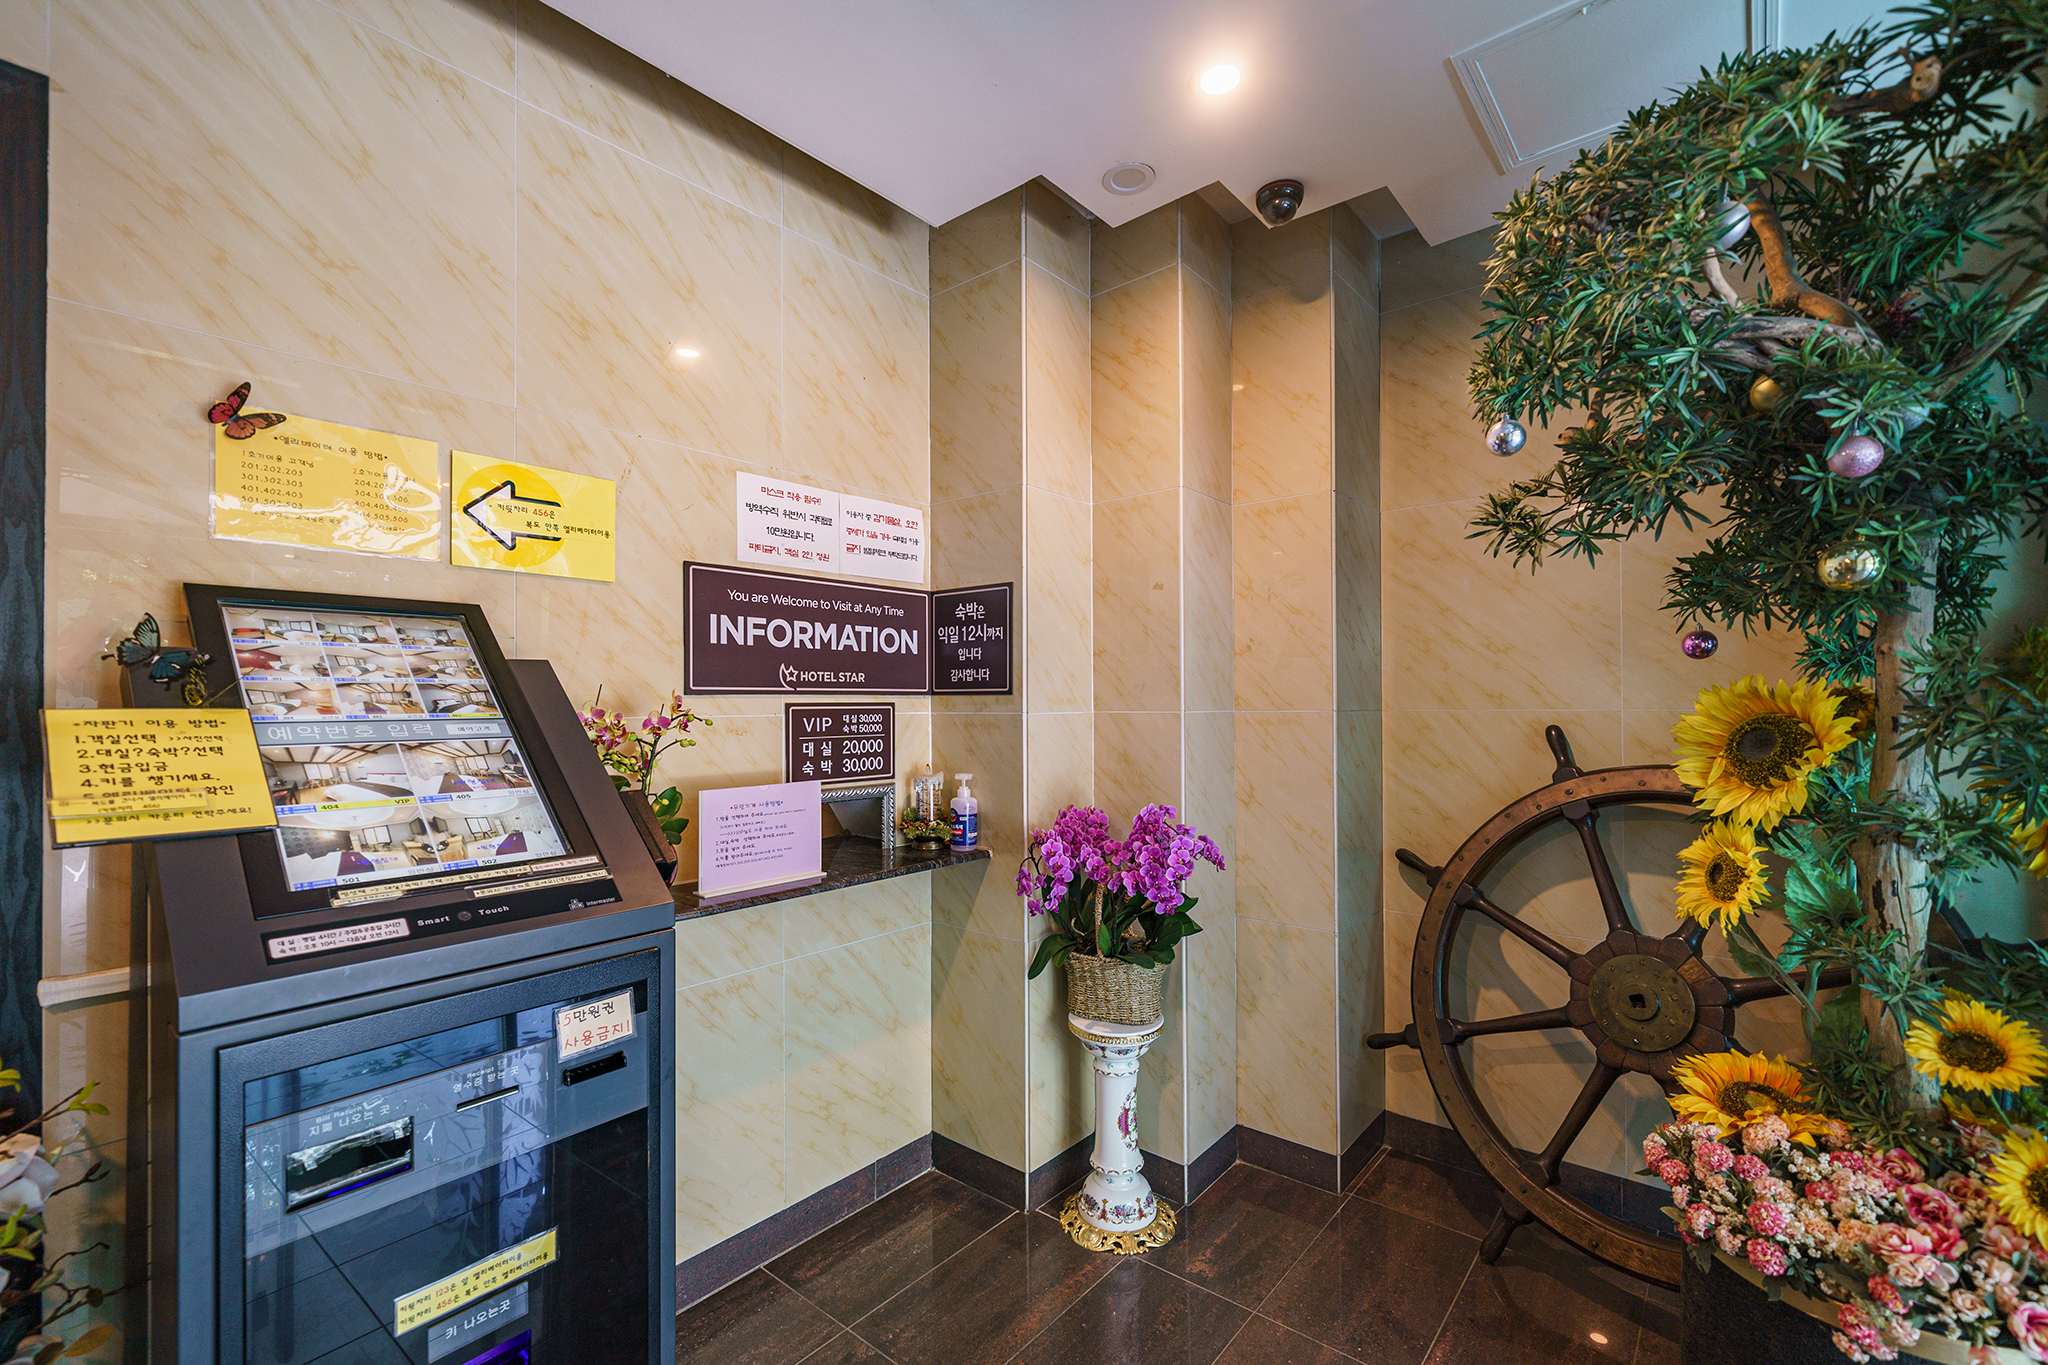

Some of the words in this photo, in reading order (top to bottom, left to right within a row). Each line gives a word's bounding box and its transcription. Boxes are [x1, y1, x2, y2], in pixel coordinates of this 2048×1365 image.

[338, 446, 358, 457] 이용
[364, 450, 383, 461] 방법
[241, 461, 303, 477] 201.202.203
[241, 472, 303, 488] 301.302.303
[241, 484, 303, 499] 401.402.403
[760, 486, 784, 499] 마스크
[532, 508, 556, 519] 456은
[782, 509, 807, 522] 위반시
[526, 520, 540, 530] 복도
[846, 543, 861, 554] 금지
[727, 588, 749, 603] You
[751, 593, 769, 604] are
[771, 593, 819, 609] Welcome
[820, 598, 831, 610] to
[832, 600, 853, 613] Visit
[853, 602, 864, 613] at
[864, 602, 882, 617] Any
[884, 605, 904, 617] Time
[955, 602, 986, 620] 숙박은
[710, 613, 918, 655] INFORMATION
[937, 624, 959, 644] 익일
[961, 623, 1004, 642] 12시까지
[957, 647, 982, 661] 입니다
[800, 670, 837, 683] HOTEL
[838, 671, 865, 683] STAR
[950, 668, 990, 683] 감사합니다
[83, 720, 134, 730] 자판기
[146, 719, 178, 729] 이용
[188, 718, 219, 729] 방법
[803, 717, 832, 732] VIP
[858, 714, 883, 723] 30,000
[268, 725, 377, 741] 예약번호
[387, 723, 434, 738] 입력
[859, 723, 883, 733] 50,000
[75, 733, 157, 745] 1.객실선택
[77, 745, 224, 759] 2.대실?숙박?선택
[842, 739, 884, 756] 20,000
[78, 761, 169, 774] 3.현금입금
[842, 756, 884, 773] 30,000
[81, 775, 136, 788] 4.키를
[417, 915, 450, 927] Smart
[478, 905, 510, 916] Touch
[563, 1001, 615, 1027] 5만원권
[564, 1020, 630, 1050] 사용금지!
[453, 1075, 482, 1093] 영수증
[510, 1066, 519, 1076] 곳
[466, 1066, 494, 1079] Receipt
[309, 1122, 333, 1137] 지폐
[339, 1111, 374, 1127] 나오는
[380, 1105, 390, 1116] 곳
[316, 1113, 331, 1123] Bill
[333, 1106, 362, 1119] Return
[445, 1325, 457, 1340] 키
[464, 1299, 511, 1330] 나오는곳
